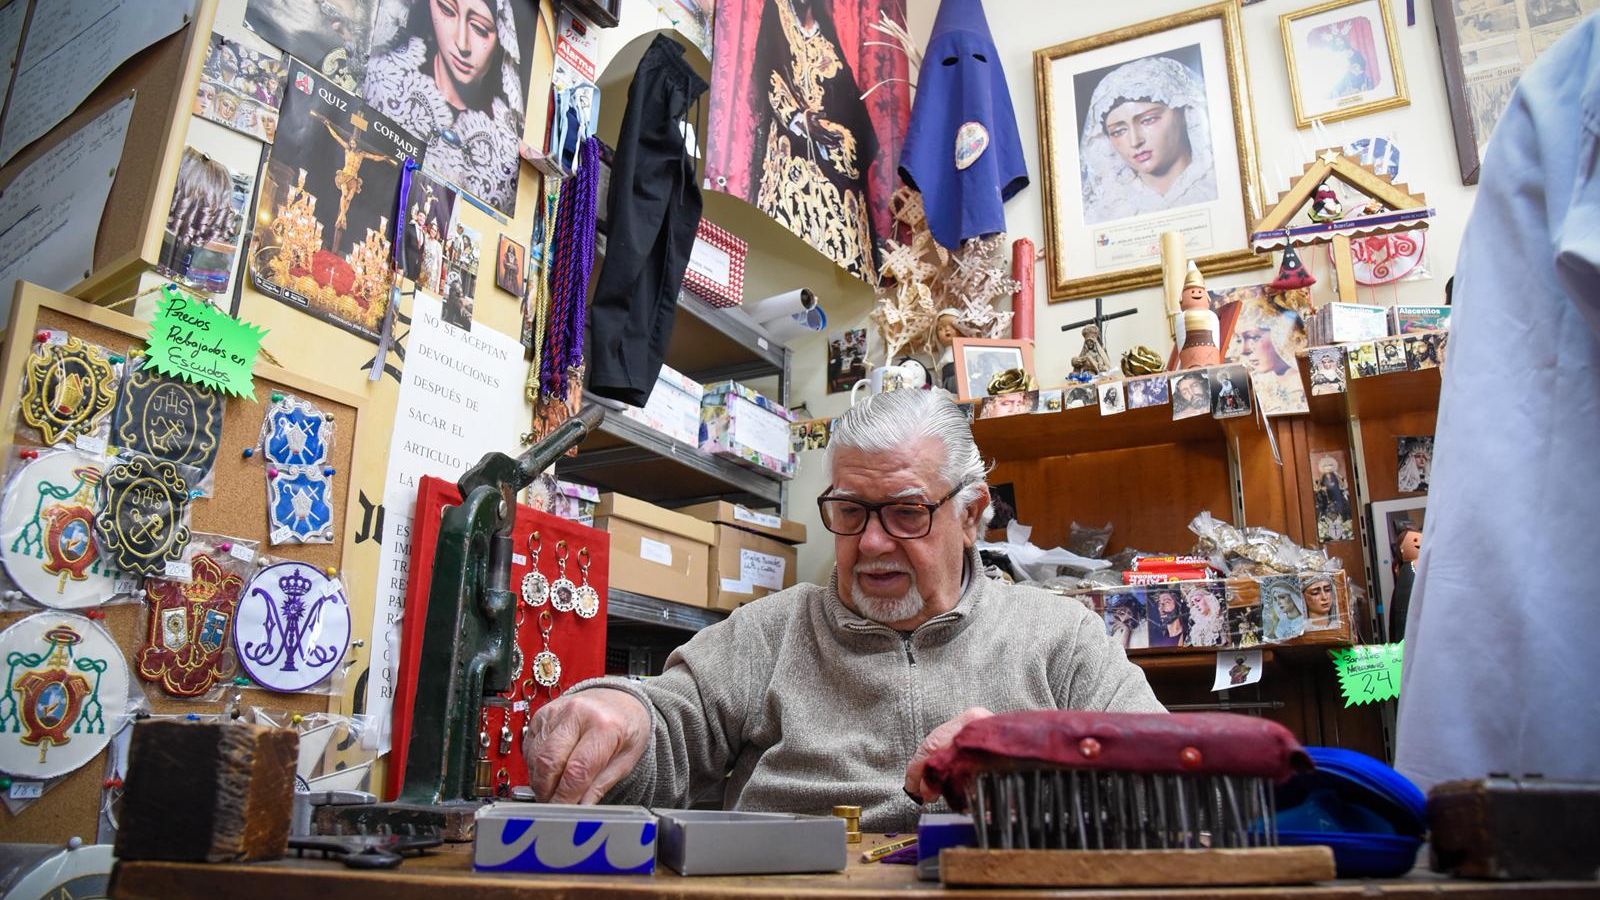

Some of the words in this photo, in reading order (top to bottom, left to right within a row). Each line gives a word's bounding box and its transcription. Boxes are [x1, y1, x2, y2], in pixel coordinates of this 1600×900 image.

[318, 87, 348, 112] QUIZ
[373, 121, 419, 157] COFRADE
[165, 298, 210, 331] Precios
[1399, 307, 1441, 315] Alacenitos
[166, 325, 227, 359] Rebajados
[231, 354, 246, 366] en
[423, 312, 439, 329] NO
[443, 322, 457, 338] SE
[460, 332, 509, 361] ACEPTAN
[167, 346, 230, 382] Escudos
[418, 343, 501, 389] DEVOLUCIONES
[413, 374, 462, 403] DESPUÉS
[465, 397, 479, 413] DE
[408, 406, 447, 431] SACAR
[451, 423, 465, 439] EL
[403, 440, 461, 469] ARTICULO
[399, 472, 414, 488] LA
[1361, 670, 1393, 695] 24
